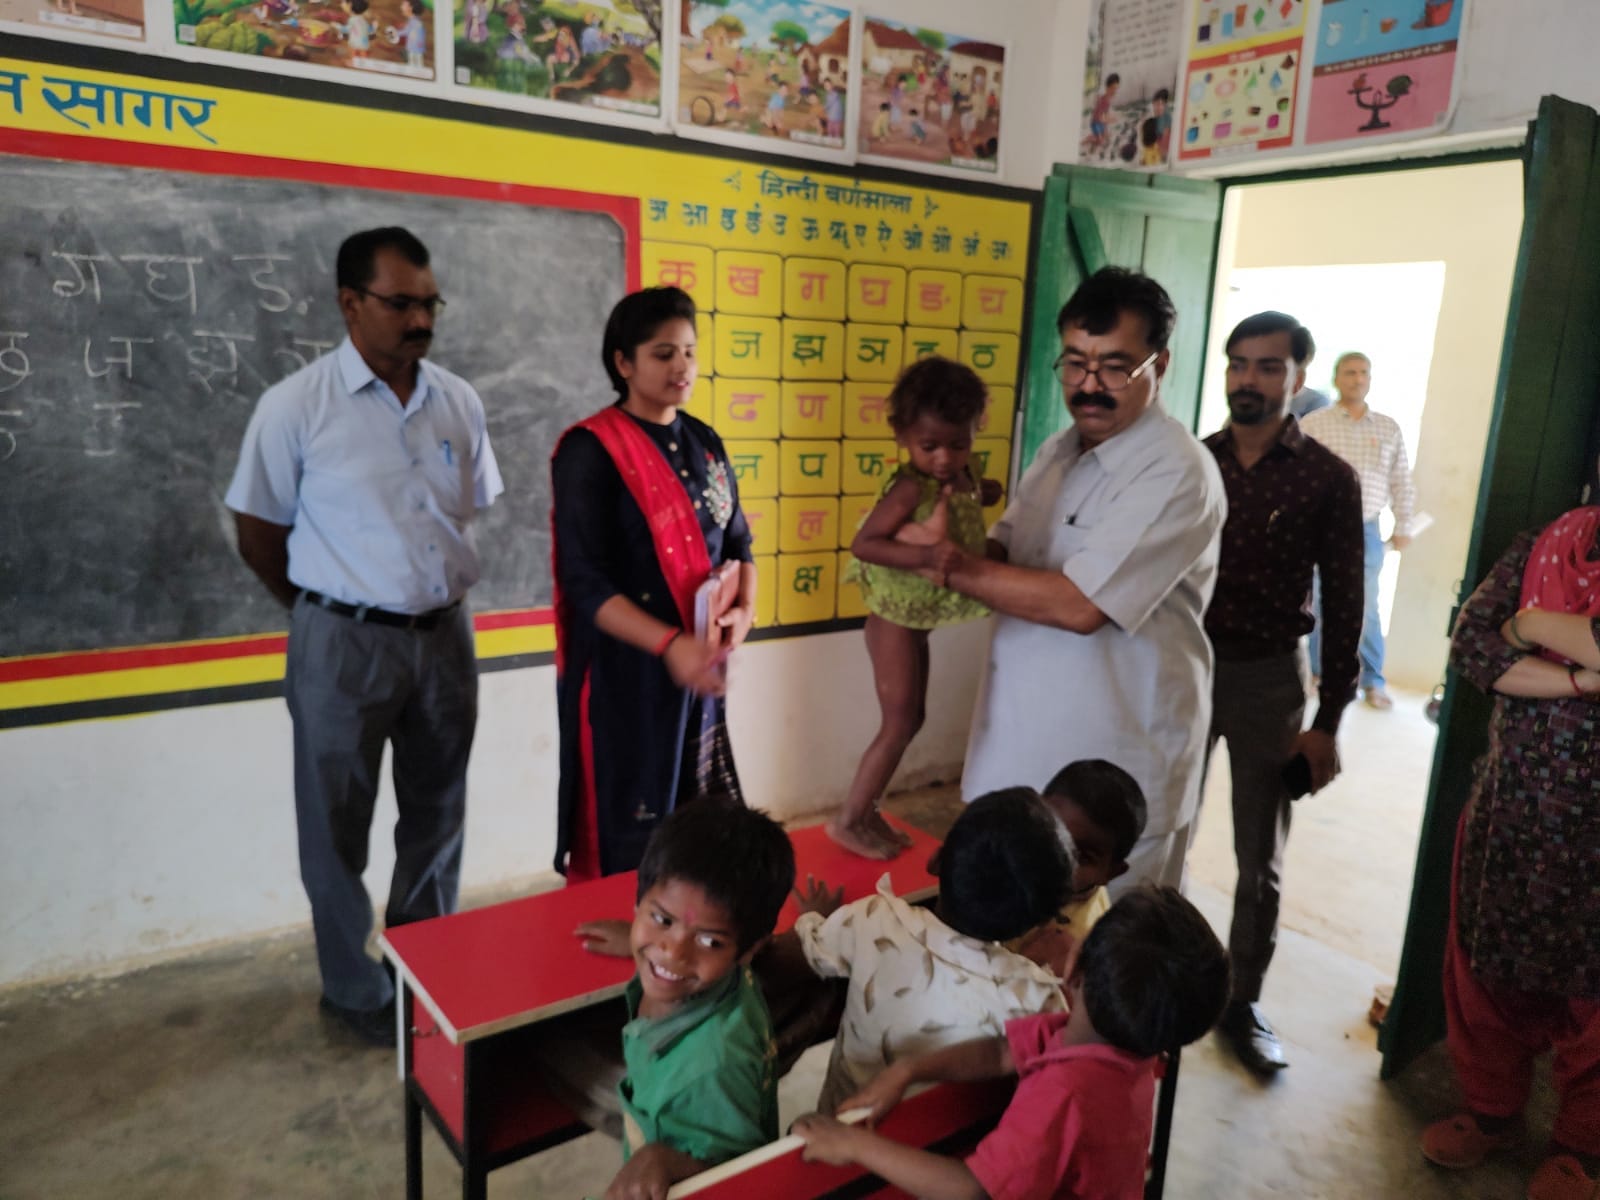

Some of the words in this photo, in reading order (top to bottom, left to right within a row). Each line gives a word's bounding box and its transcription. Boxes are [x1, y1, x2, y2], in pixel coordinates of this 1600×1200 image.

[41, 75, 218, 144] सागर
[757, 169, 819, 201] हिन्दी
[51, 252, 105, 304] ग
[120, 254, 203, 315] घ
[658, 260, 697, 290] क
[727, 265, 763, 297] ख
[799, 273, 829, 302] ग
[860, 278, 891, 307] घ
[978, 287, 1008, 315] च
[84, 337, 154, 379] ज
[730, 330, 762, 359] ज
[793, 334, 827, 366] झ
[857, 337, 890, 365] ञ
[971, 344, 999, 369] ठ
[795, 395, 829, 422] ण
[799, 453, 827, 478] प
[855, 453, 885, 476] फ
[796, 511, 829, 541] ल
[793, 565, 824, 594] क्ष
